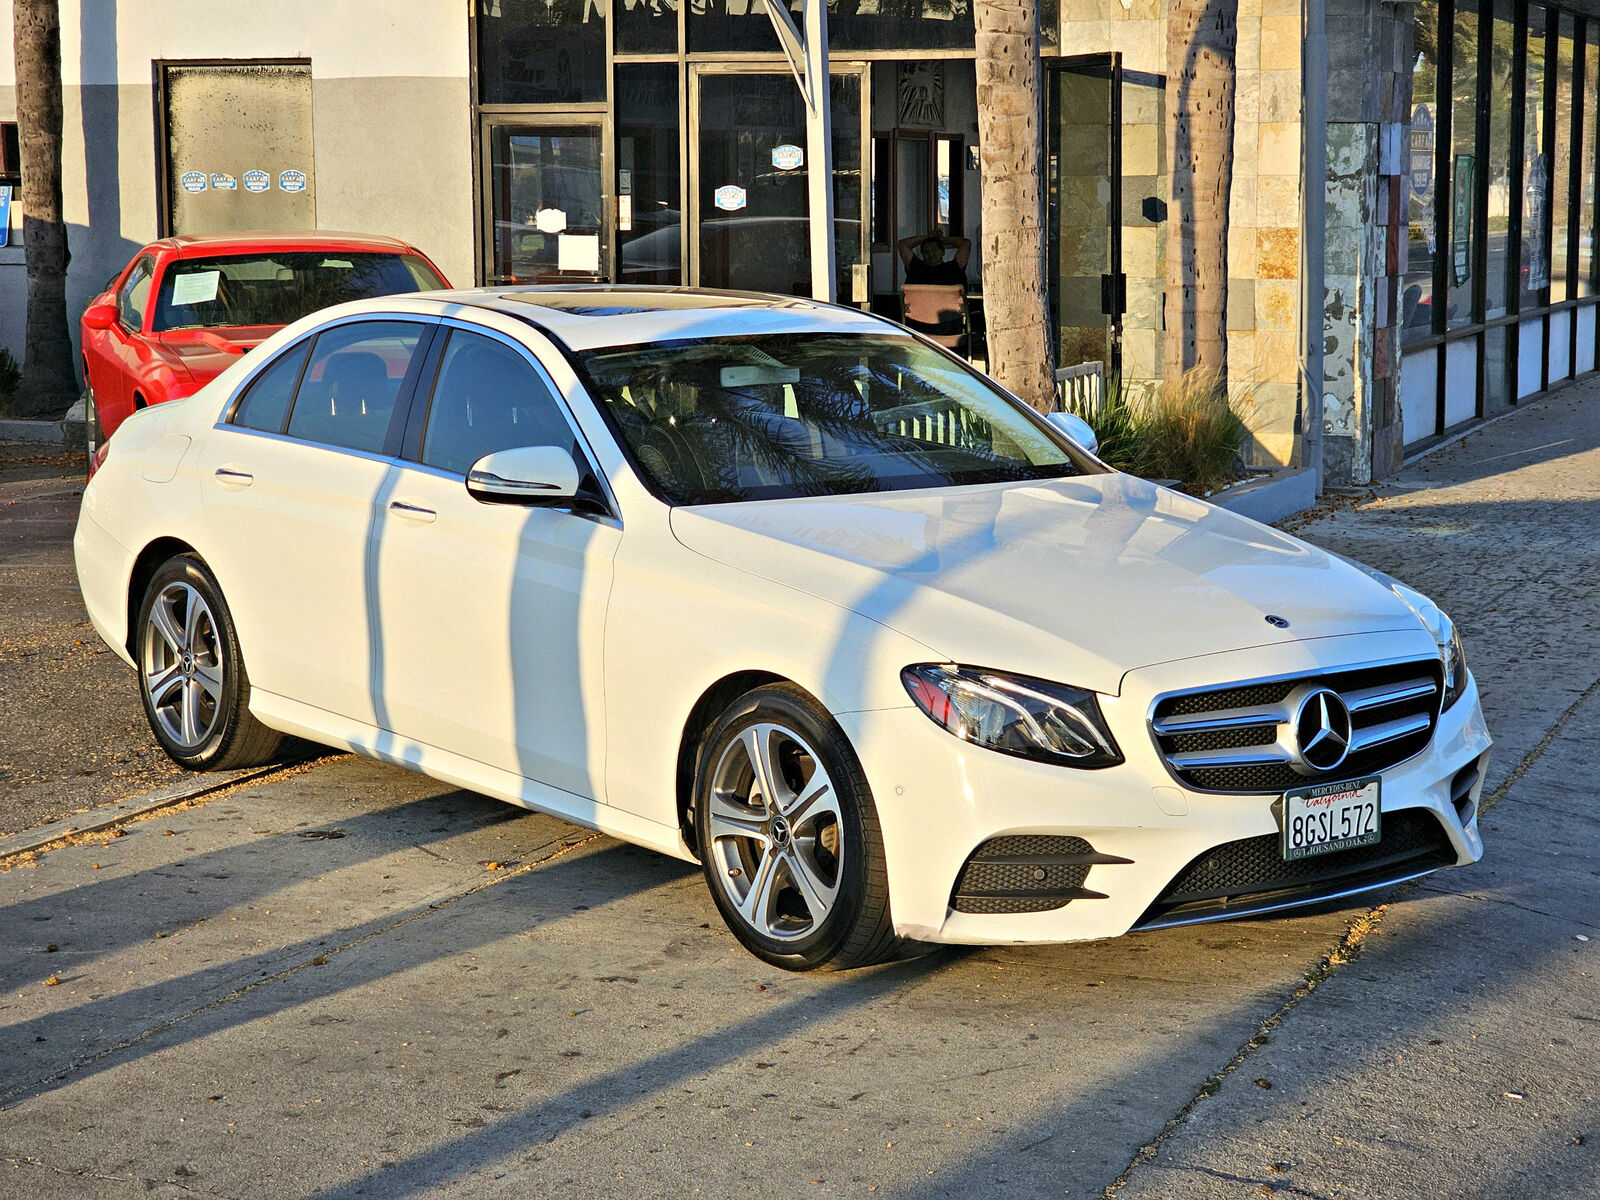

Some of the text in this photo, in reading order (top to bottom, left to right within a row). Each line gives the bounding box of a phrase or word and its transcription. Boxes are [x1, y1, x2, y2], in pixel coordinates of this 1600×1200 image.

[1305, 789, 1364, 809] California
[1311, 781, 1361, 797] MERCEDES-BENZ
[1293, 803, 1374, 847] 8GSL572
